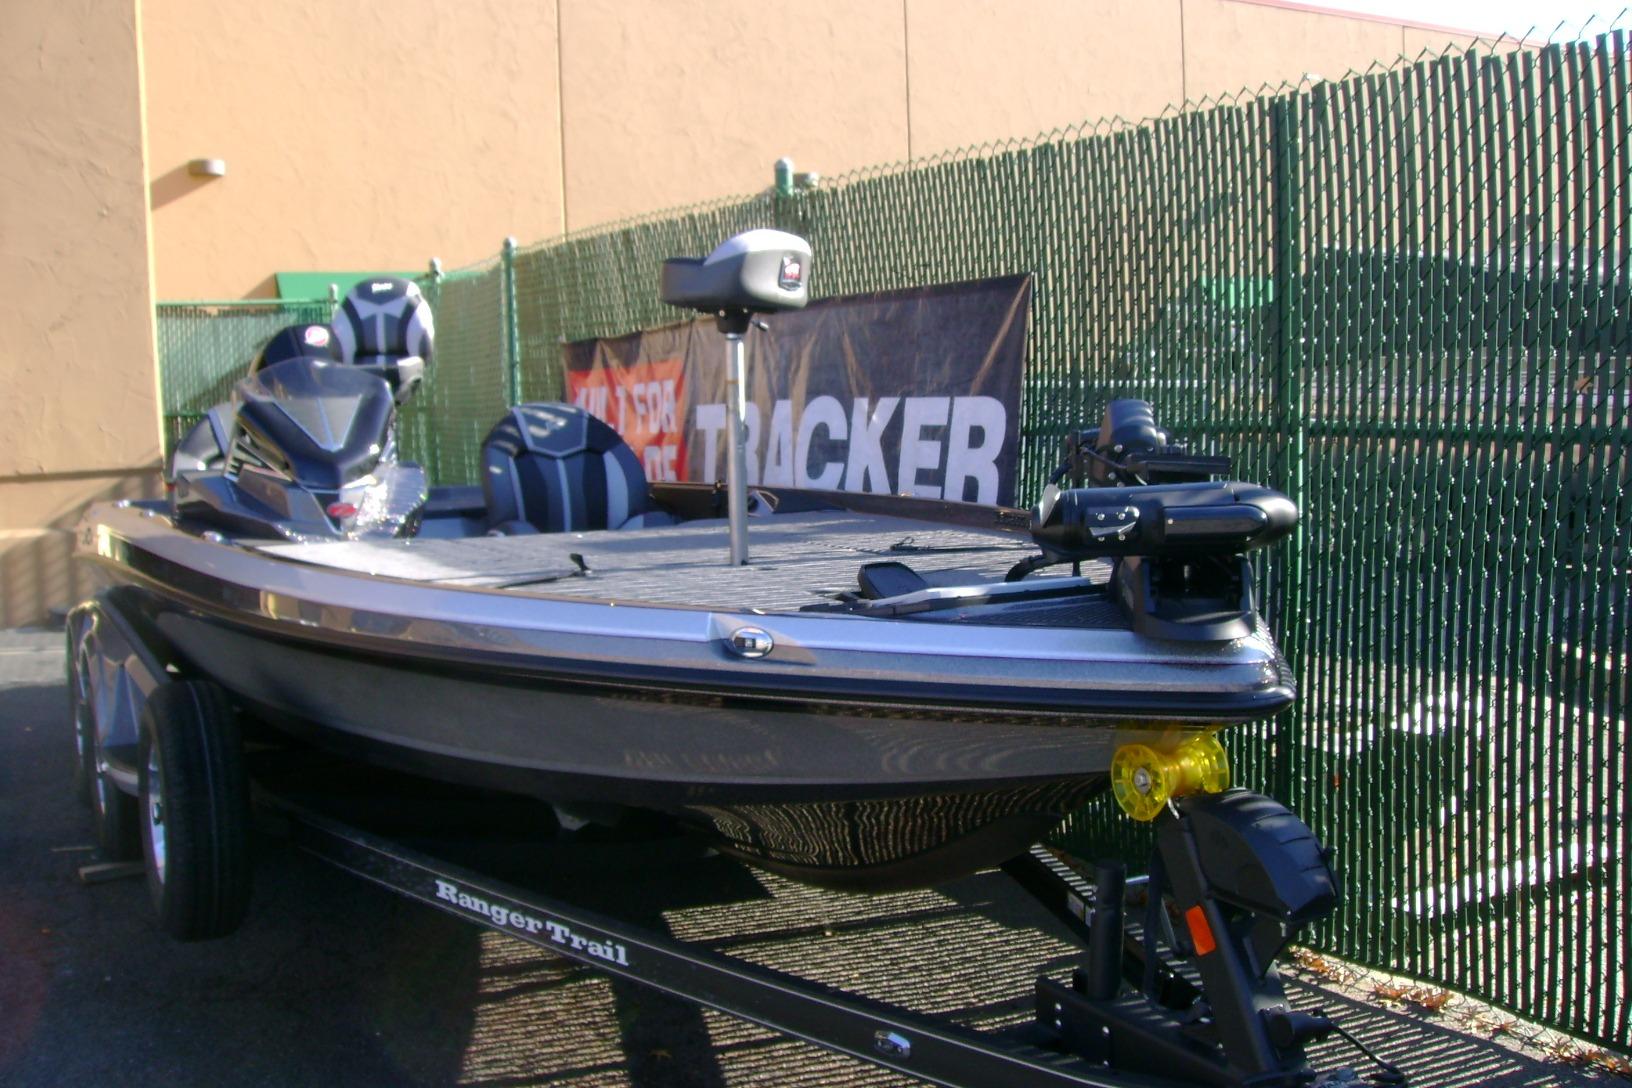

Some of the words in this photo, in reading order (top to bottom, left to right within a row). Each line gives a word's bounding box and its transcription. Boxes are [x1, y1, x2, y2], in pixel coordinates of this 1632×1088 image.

[633, 379, 677, 434] FOR
[696, 396, 1006, 506] TRACKER
[435, 879, 543, 934] Ranger
[546, 920, 629, 966] Trail
